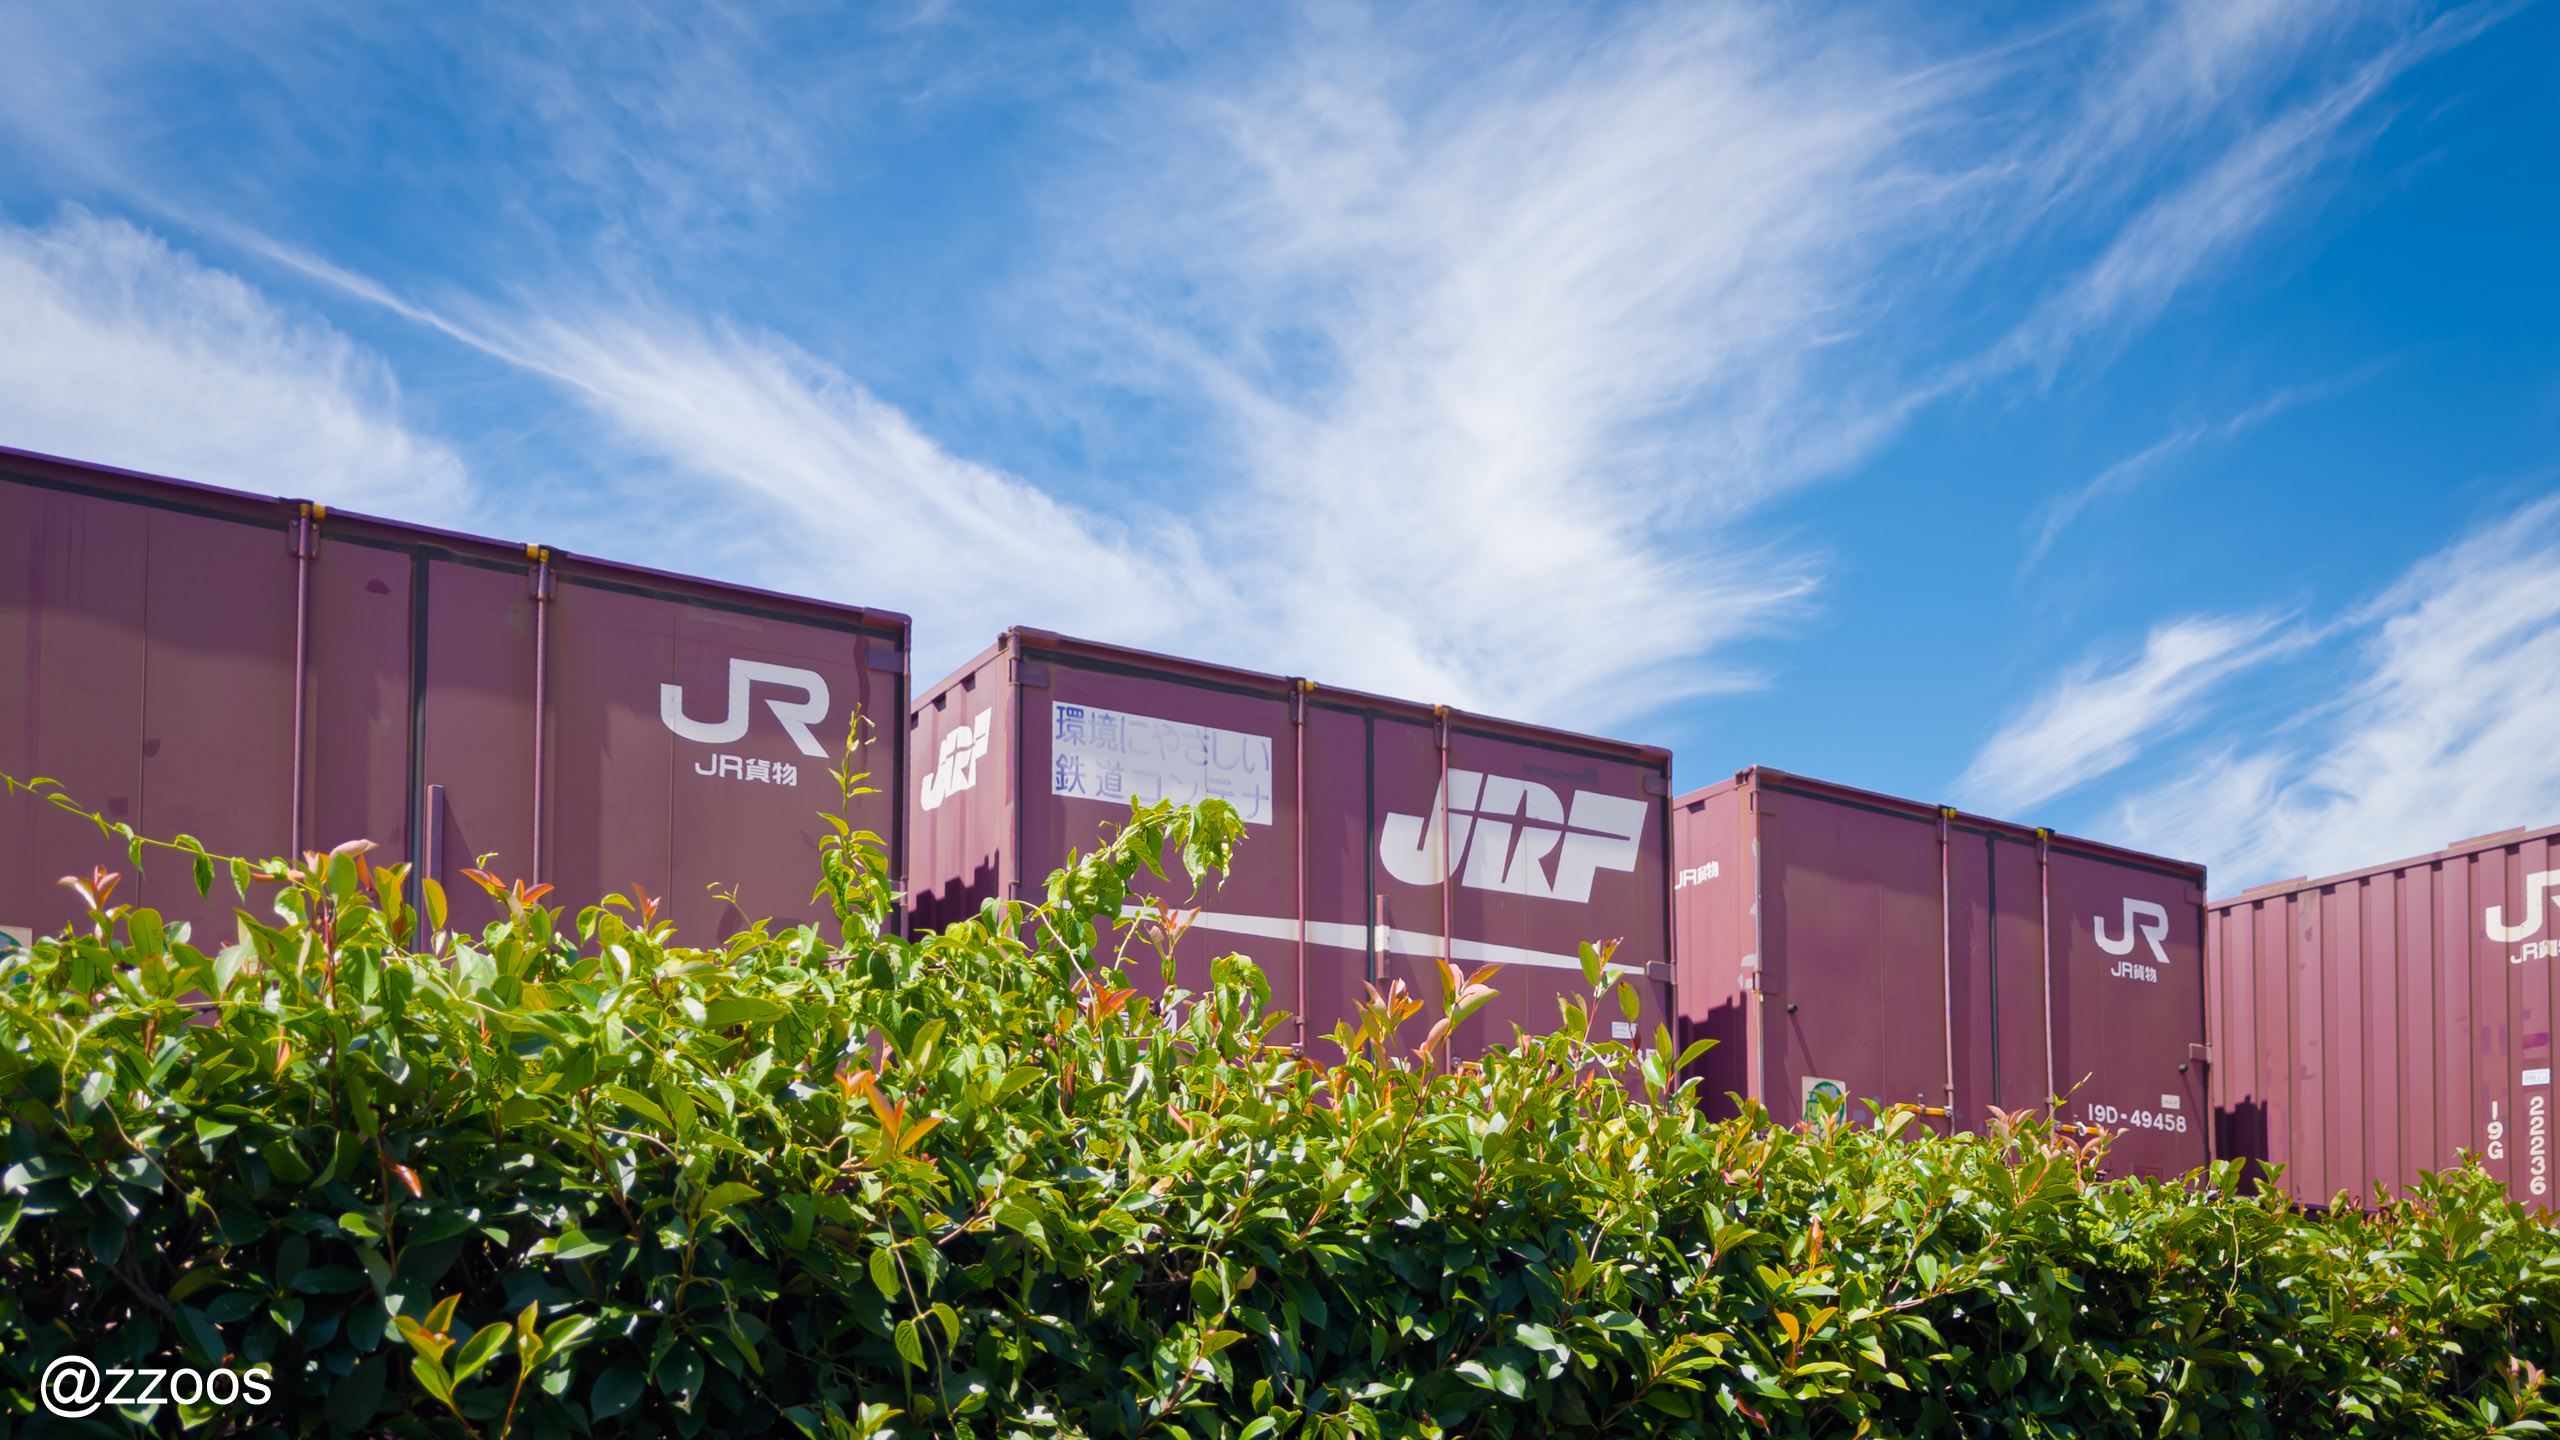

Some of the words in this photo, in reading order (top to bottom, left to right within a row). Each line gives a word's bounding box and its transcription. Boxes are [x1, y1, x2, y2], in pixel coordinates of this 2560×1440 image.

[660, 657, 830, 758] JR
[1055, 705, 1270, 774] 環境にやさしい
[694, 753, 797, 786] JR貨物
[920, 706, 992, 811] JRF
[1055, 753, 1269, 819] 鉄道コンテナ
[1379, 768, 1648, 904] JRF
[2093, 897, 2170, 964] JR
[2510, 939, 2560, 964] JR貨
[2110, 961, 2157, 983] JR貨物
[2529, 1096, 2546, 1195] 22236
